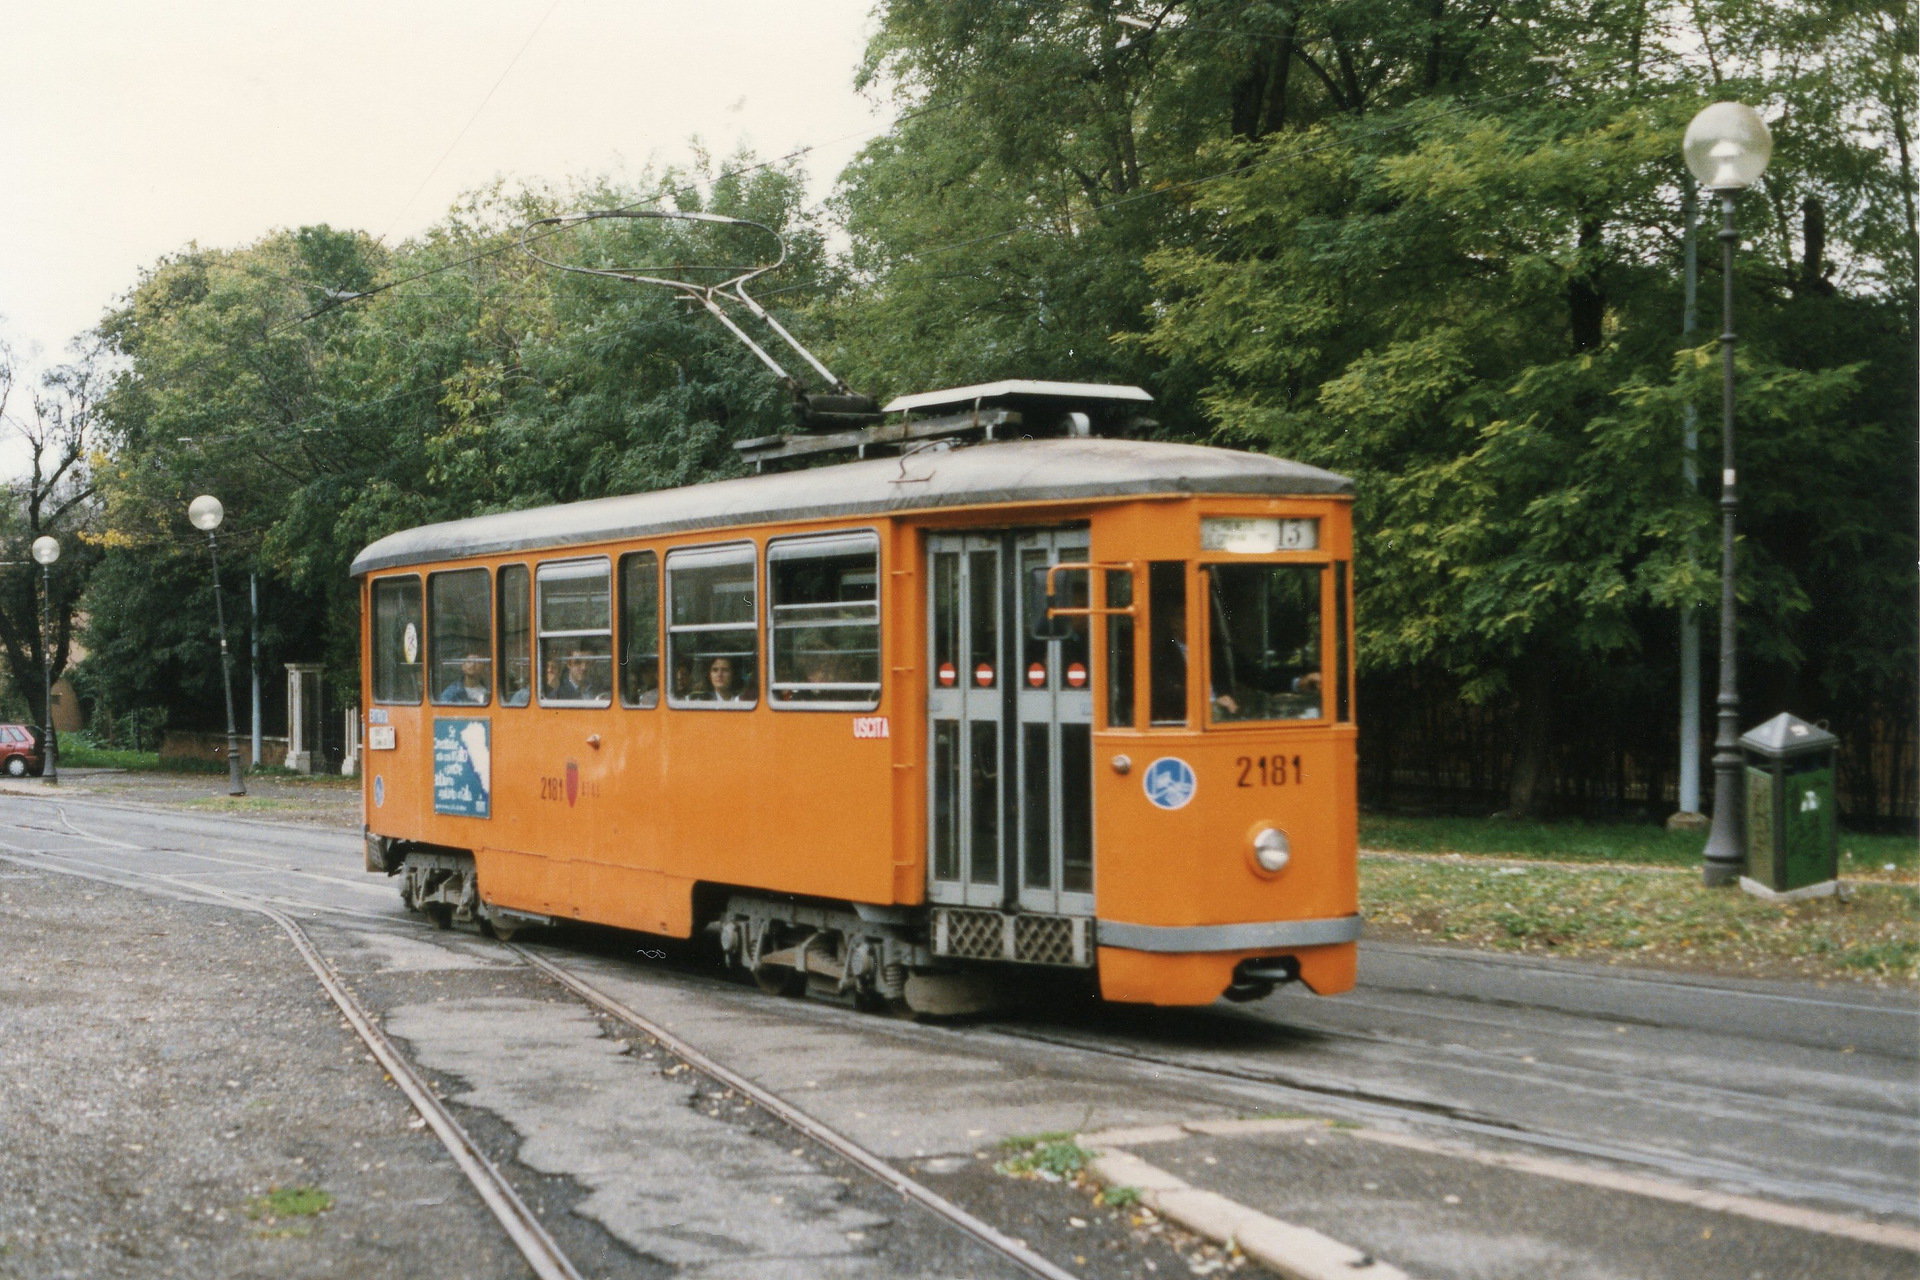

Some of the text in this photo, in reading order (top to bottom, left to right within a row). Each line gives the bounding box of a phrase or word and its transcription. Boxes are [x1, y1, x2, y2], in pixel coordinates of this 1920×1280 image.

[853, 717, 889, 738] USCITA
[1237, 755, 1302, 787] 2181
[540, 776, 563, 801] 2181
